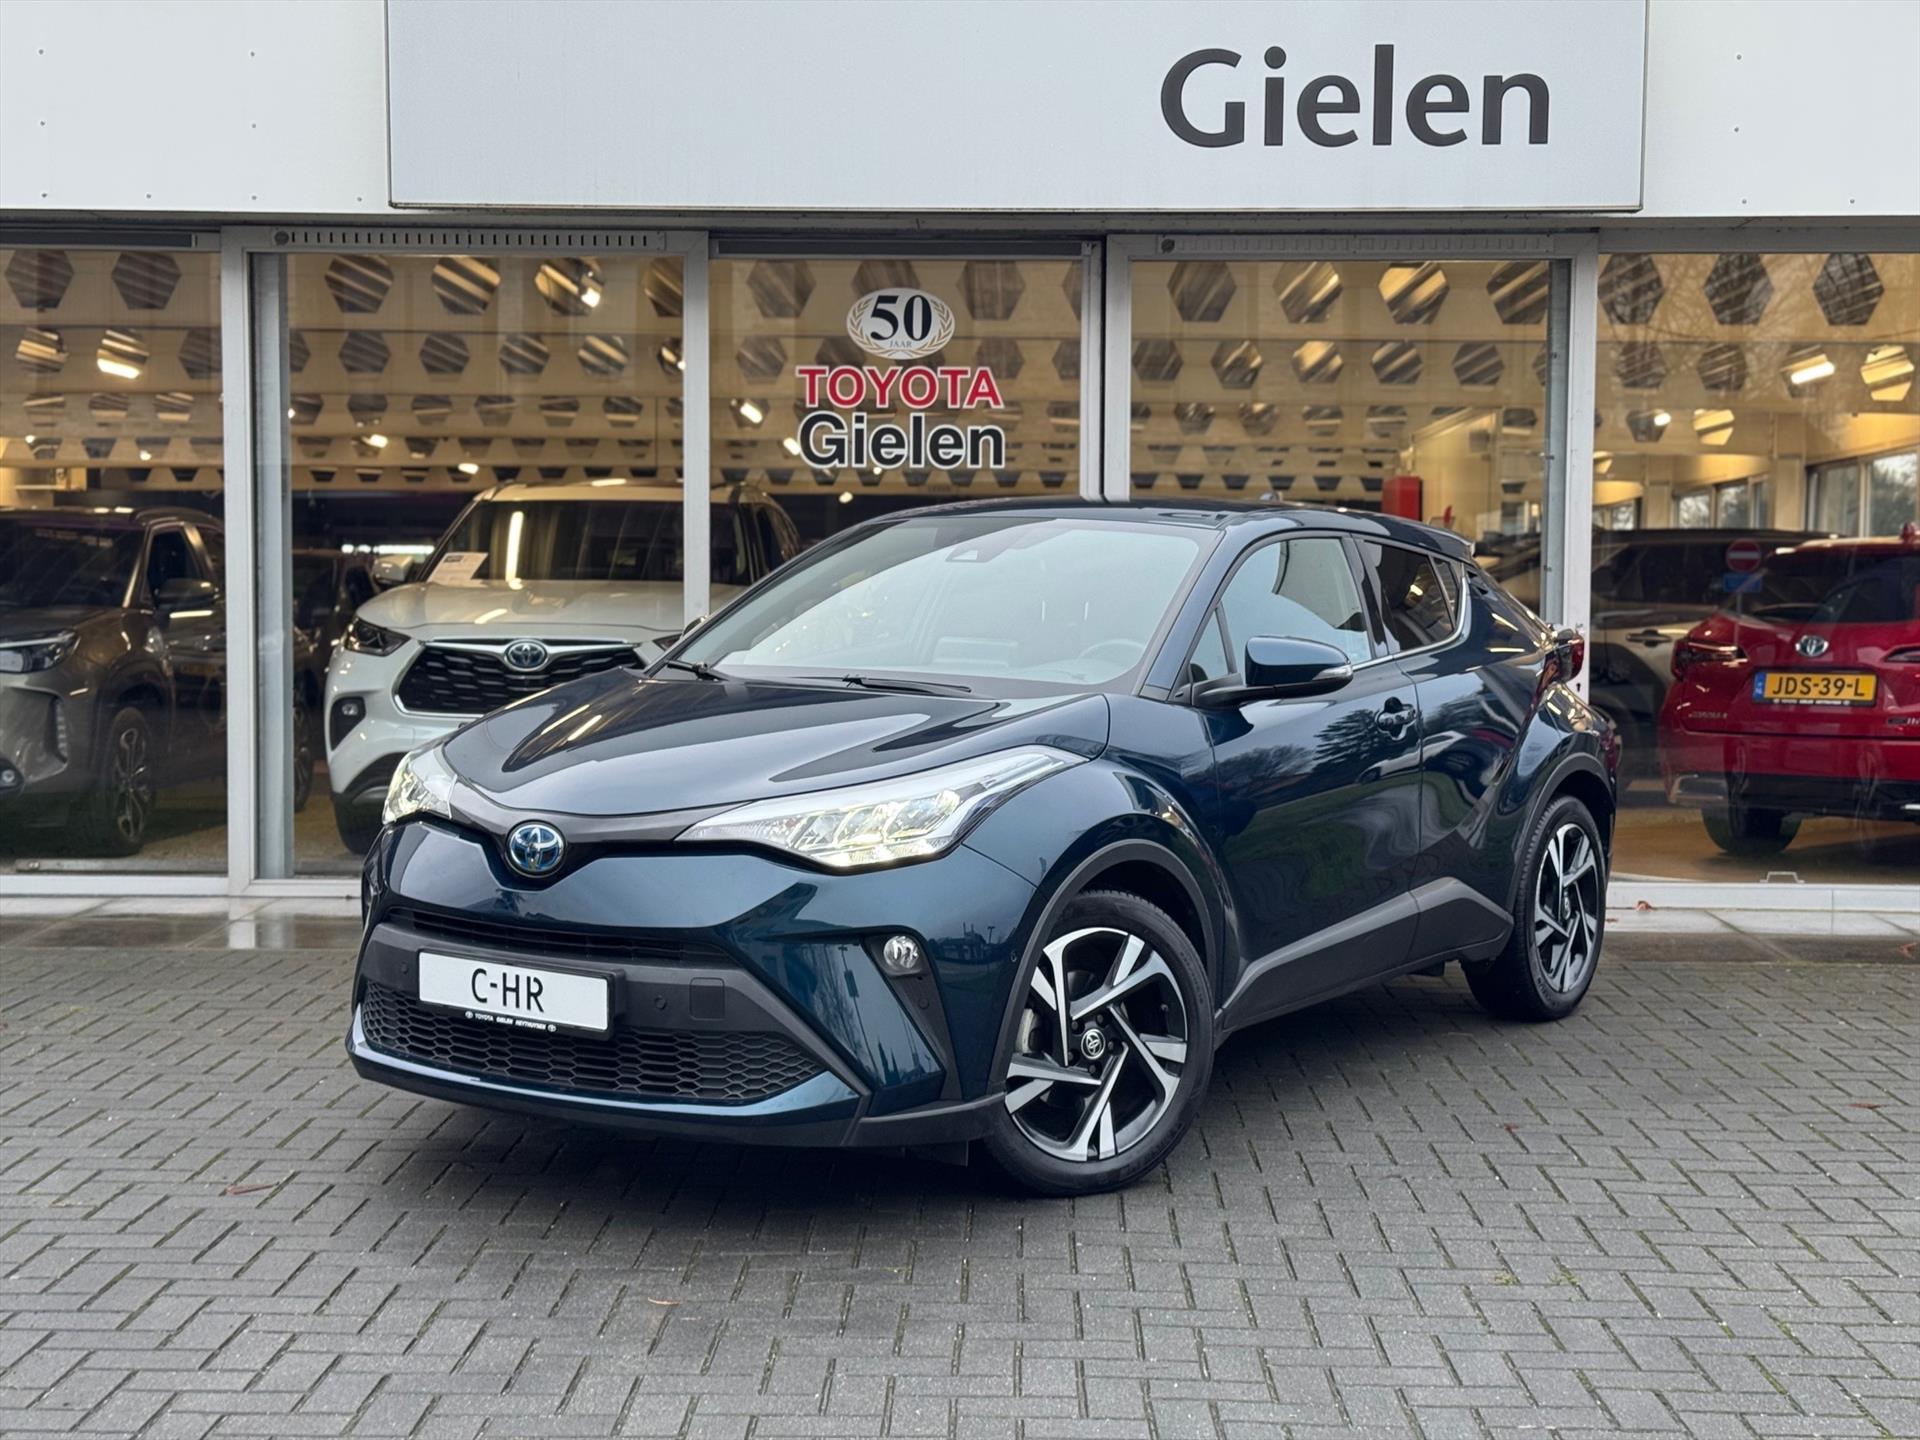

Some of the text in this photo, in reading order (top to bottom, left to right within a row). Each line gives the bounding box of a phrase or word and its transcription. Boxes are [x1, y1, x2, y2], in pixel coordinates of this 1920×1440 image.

[1160, 44, 1550, 148] Gielen
[870, 294, 932, 341] 50
[796, 366, 1004, 408] TOYOTA
[798, 411, 1006, 468] Gielen
[1772, 677, 1865, 697] JDS-39-L
[471, 968, 544, 1012] C-HR
